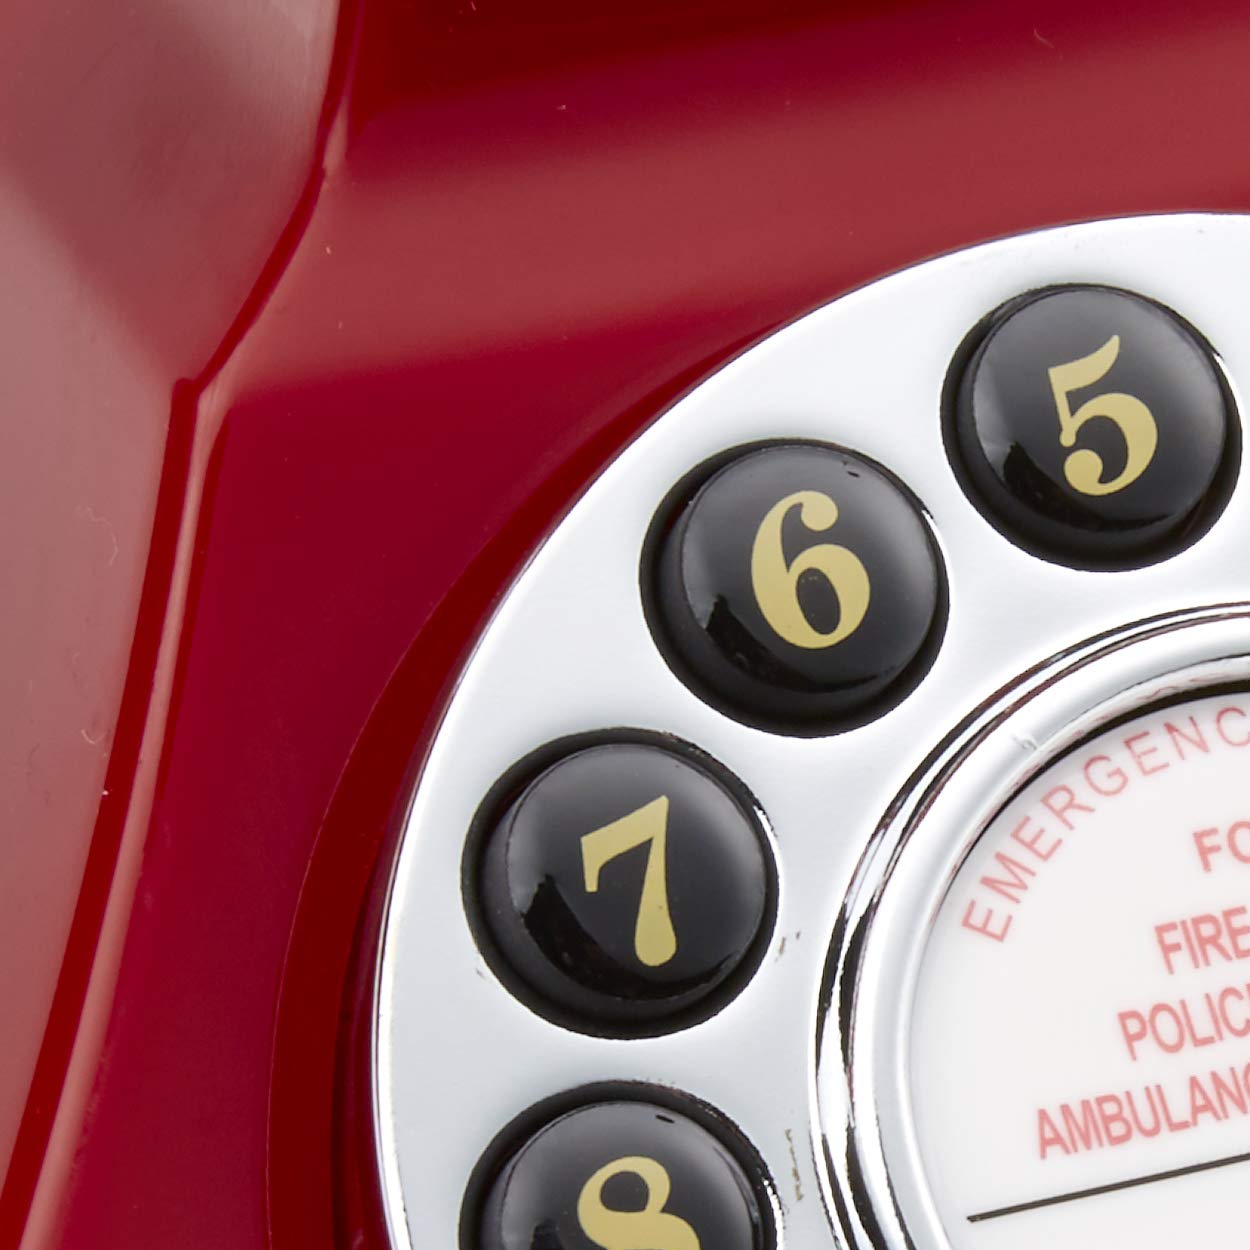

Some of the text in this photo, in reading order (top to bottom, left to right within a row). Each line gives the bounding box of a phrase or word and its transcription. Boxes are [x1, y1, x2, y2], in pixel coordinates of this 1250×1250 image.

[1050, 338, 1158, 497] 5
[750, 489, 872, 650] 6
[580, 796, 677, 968] 7
